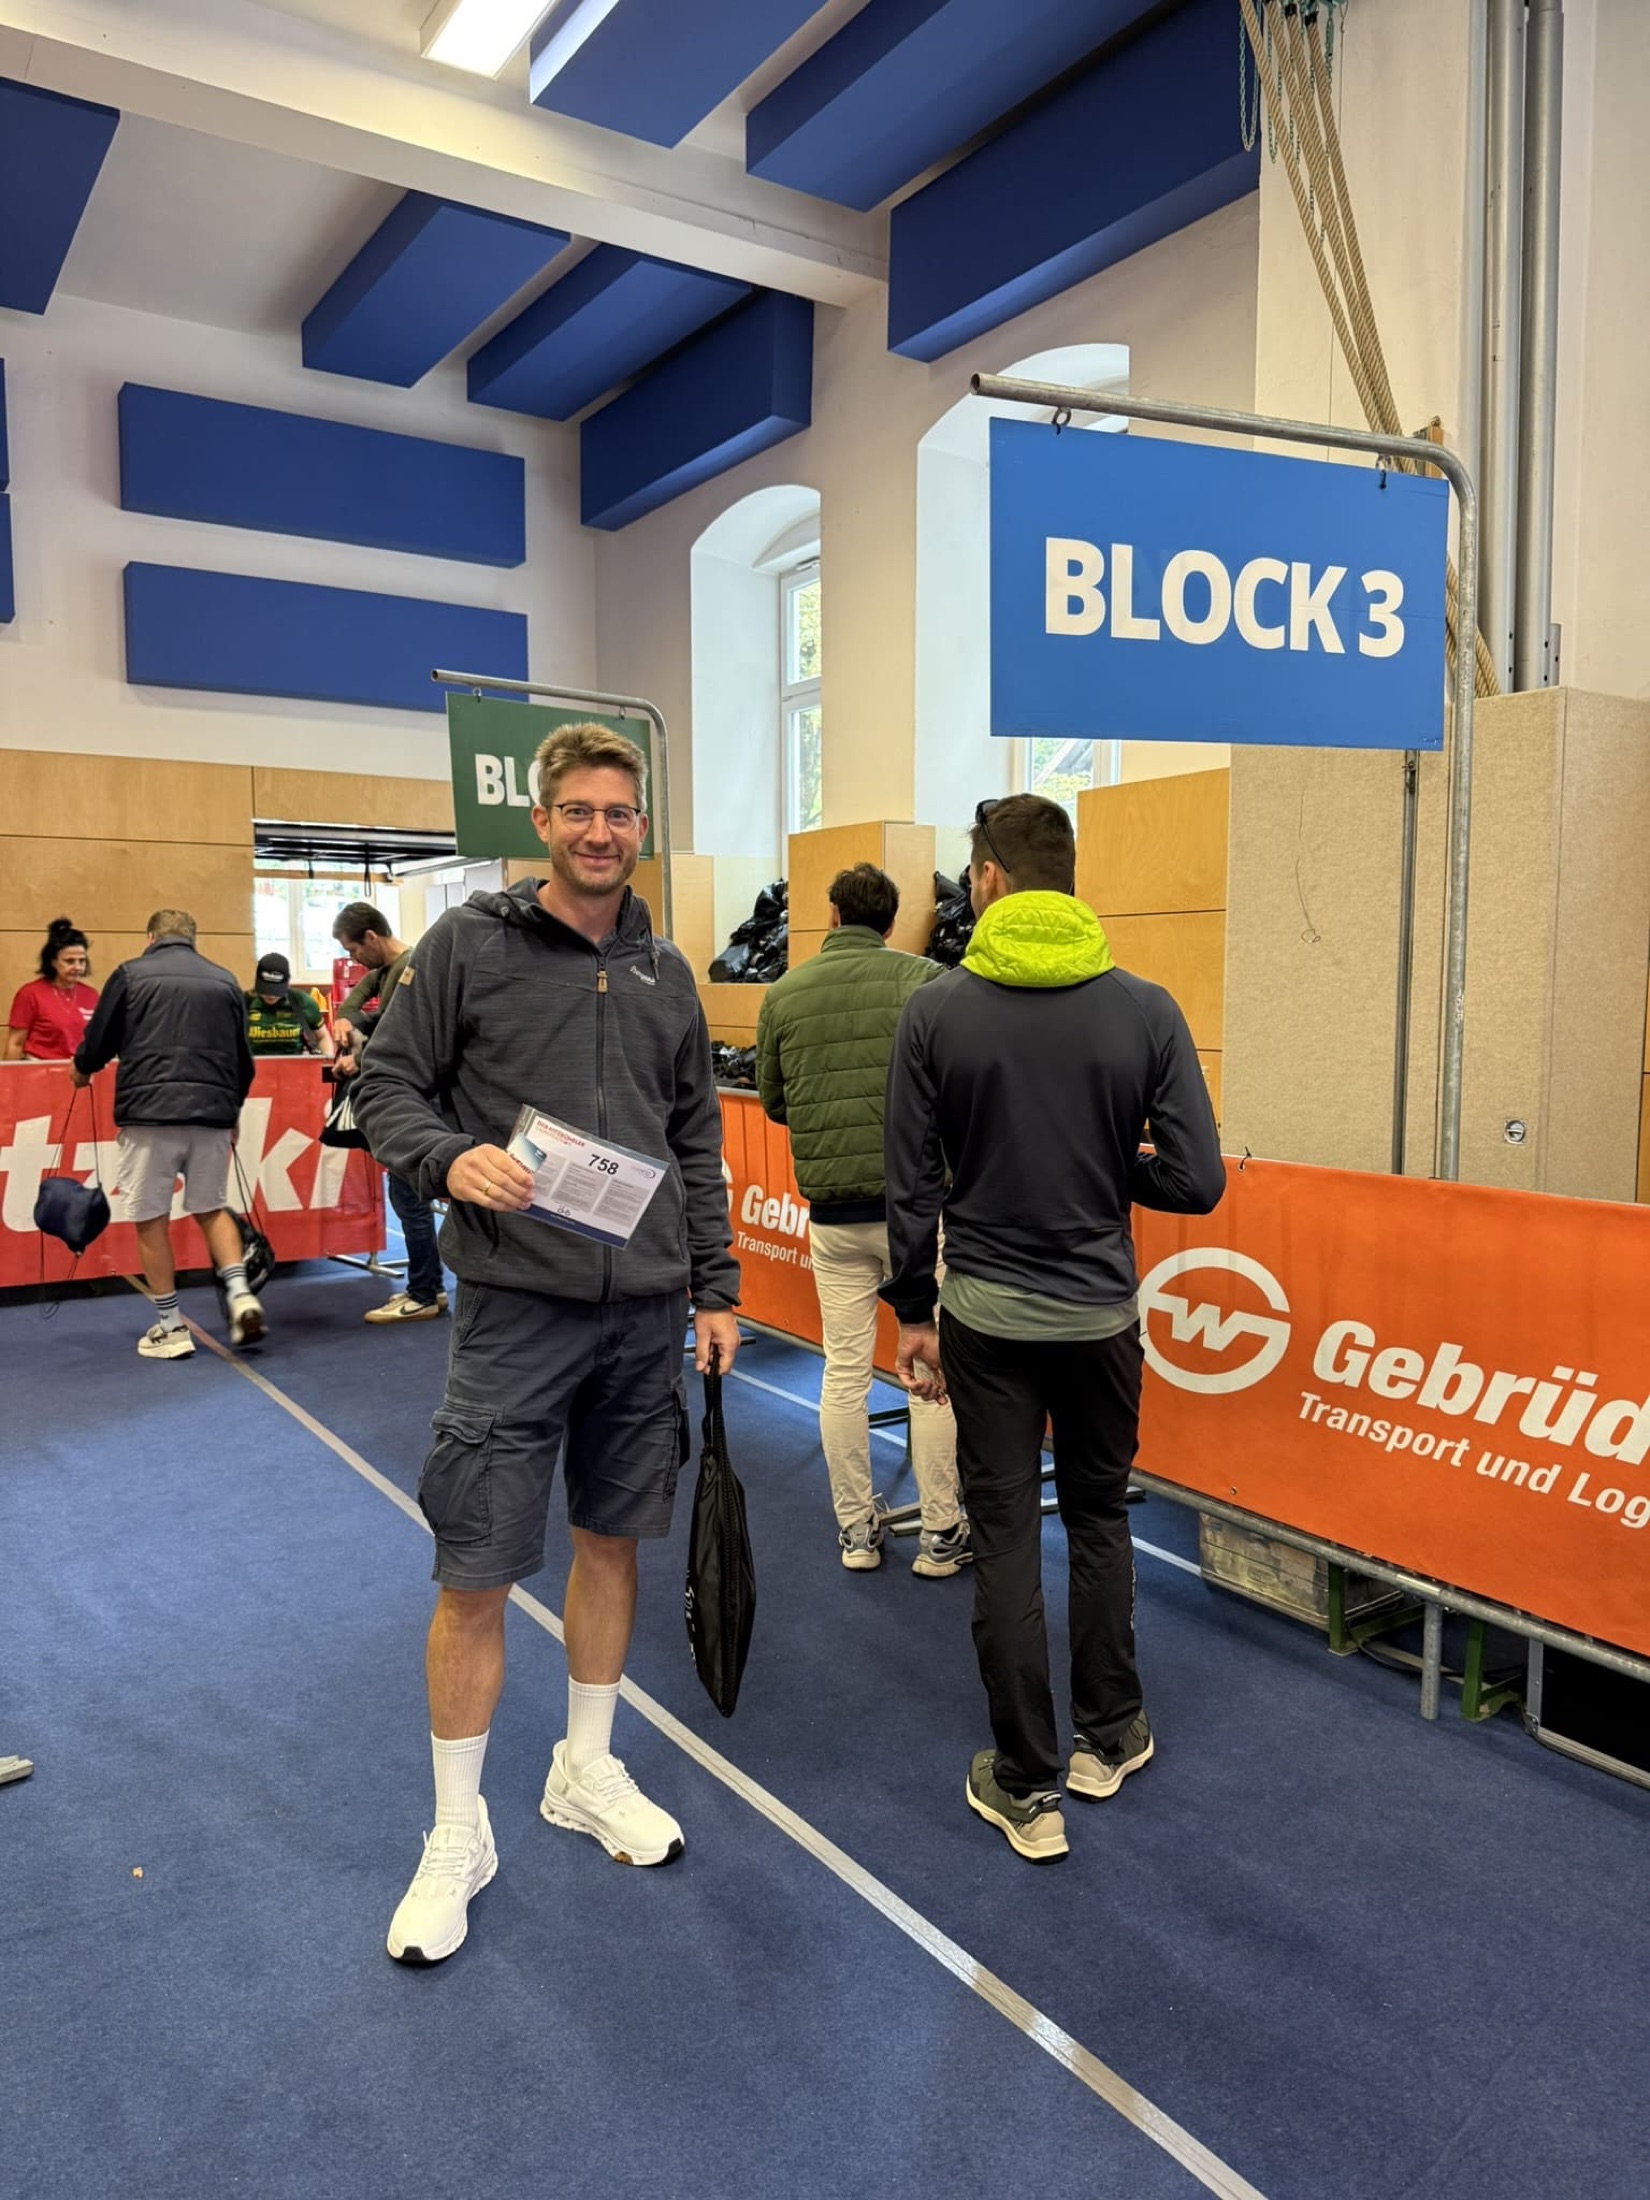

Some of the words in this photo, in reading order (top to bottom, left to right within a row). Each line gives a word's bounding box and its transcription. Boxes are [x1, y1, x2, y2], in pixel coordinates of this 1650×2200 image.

[1045, 536, 1348, 654] BLOCK
[1358, 570, 1405, 658] 3
[587, 1153, 619, 1175] 758
[741, 1184, 810, 1238] Gebr
[737, 1230, 798, 1265] Transport
[1299, 1391, 1470, 1468] Transport
[1476, 1451, 1563, 1495] und
[1567, 1472, 1650, 1529] Log
